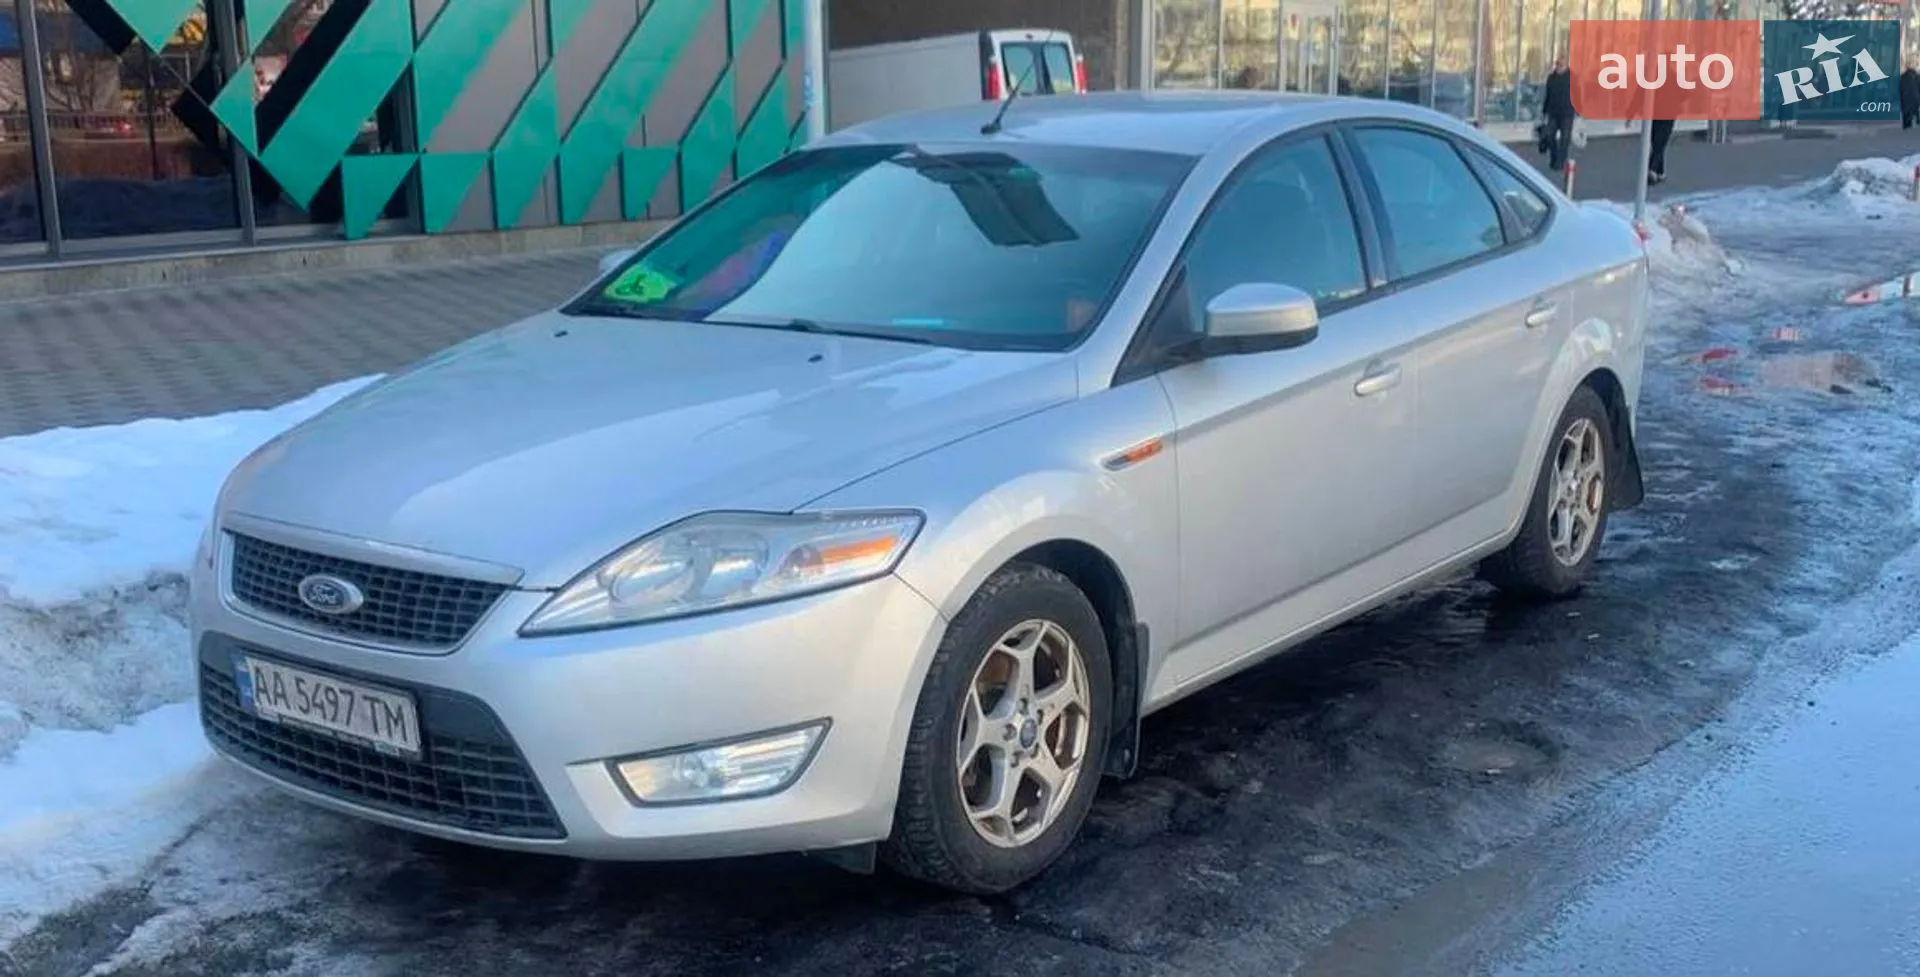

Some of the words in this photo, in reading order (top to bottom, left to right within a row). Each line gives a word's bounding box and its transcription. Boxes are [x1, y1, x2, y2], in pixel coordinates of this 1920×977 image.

[254, 667, 289, 710] AA
[295, 679, 353, 726] 5497
[363, 696, 407, 741] TM
